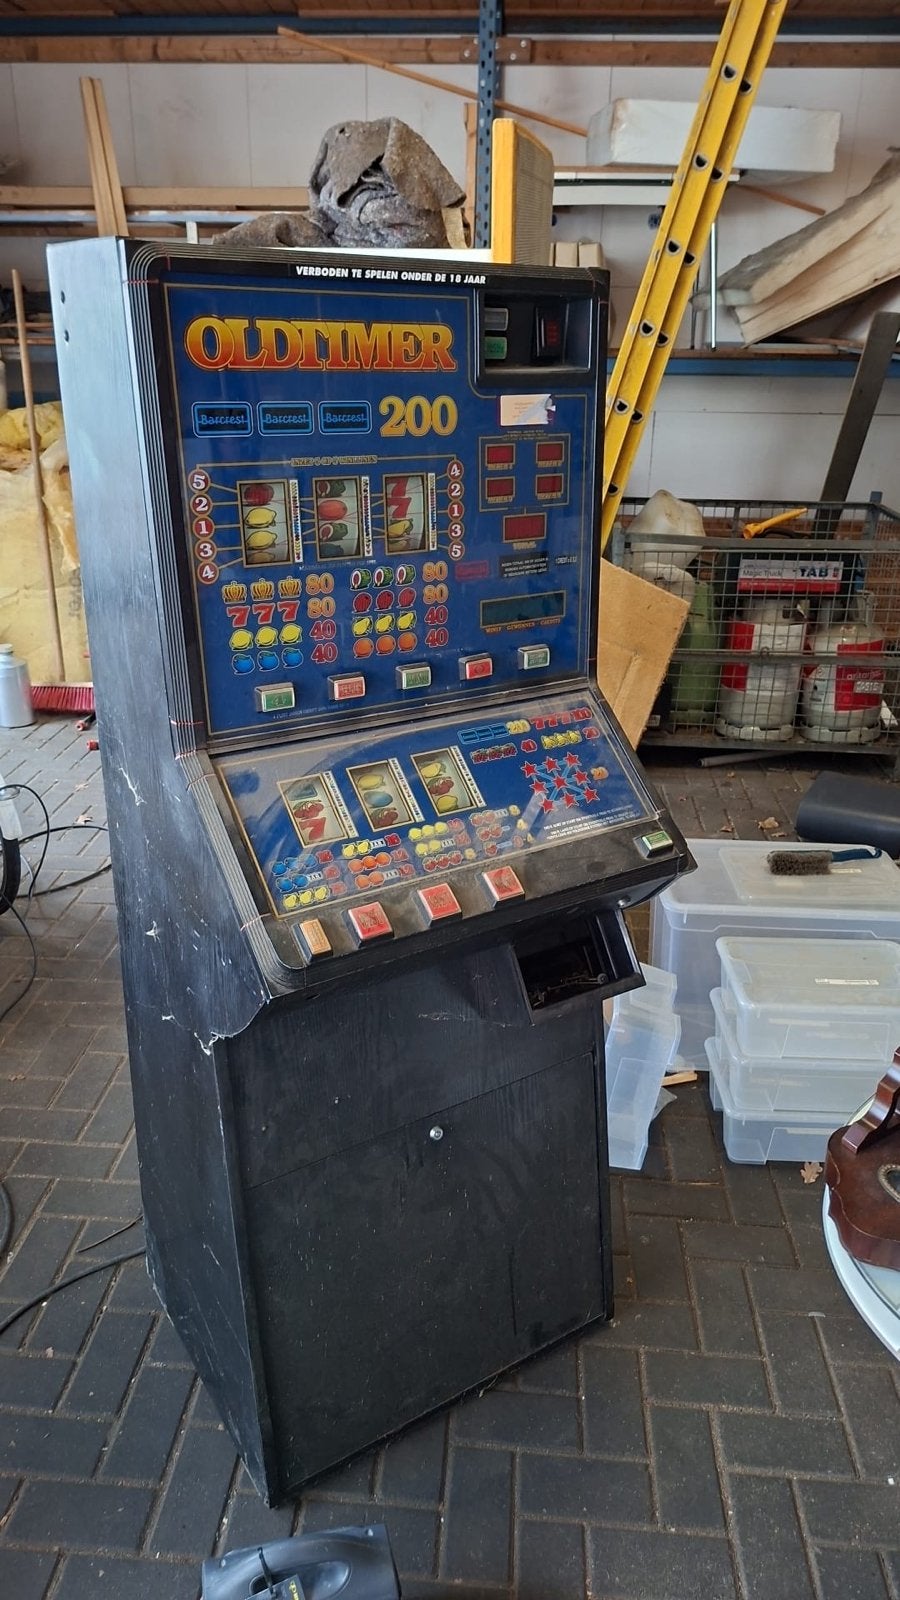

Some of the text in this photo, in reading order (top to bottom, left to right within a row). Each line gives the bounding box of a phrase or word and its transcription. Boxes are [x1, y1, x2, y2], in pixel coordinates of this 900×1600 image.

[295, 266, 487, 285] VERBODEN TE SPELEN ONDER DE 18 JAAR
[184, 315, 458, 373] OLDTIMER
[200, 395, 459, 438] Barcrest Barcrest Barcrest 200
[450, 464, 461, 478] 4
[192, 474, 207, 490] 5
[450, 484, 461, 496] 2
[196, 498, 208, 513] 2
[452, 504, 460, 517] 1
[199, 520, 209, 535] 1
[450, 524, 461, 537] 3
[199, 543, 213, 558] 3
[450, 544, 462, 557] 5
[201, 566, 216, 580] 4
[422, 561, 449, 582] 80
[305, 573, 335, 594] 80
[422, 583, 449, 605] 80
[307, 597, 336, 618] 80
[424, 605, 449, 626] 40
[309, 619, 337, 641] 40
[424, 627, 450, 648] 40
[311, 642, 339, 664] 40
